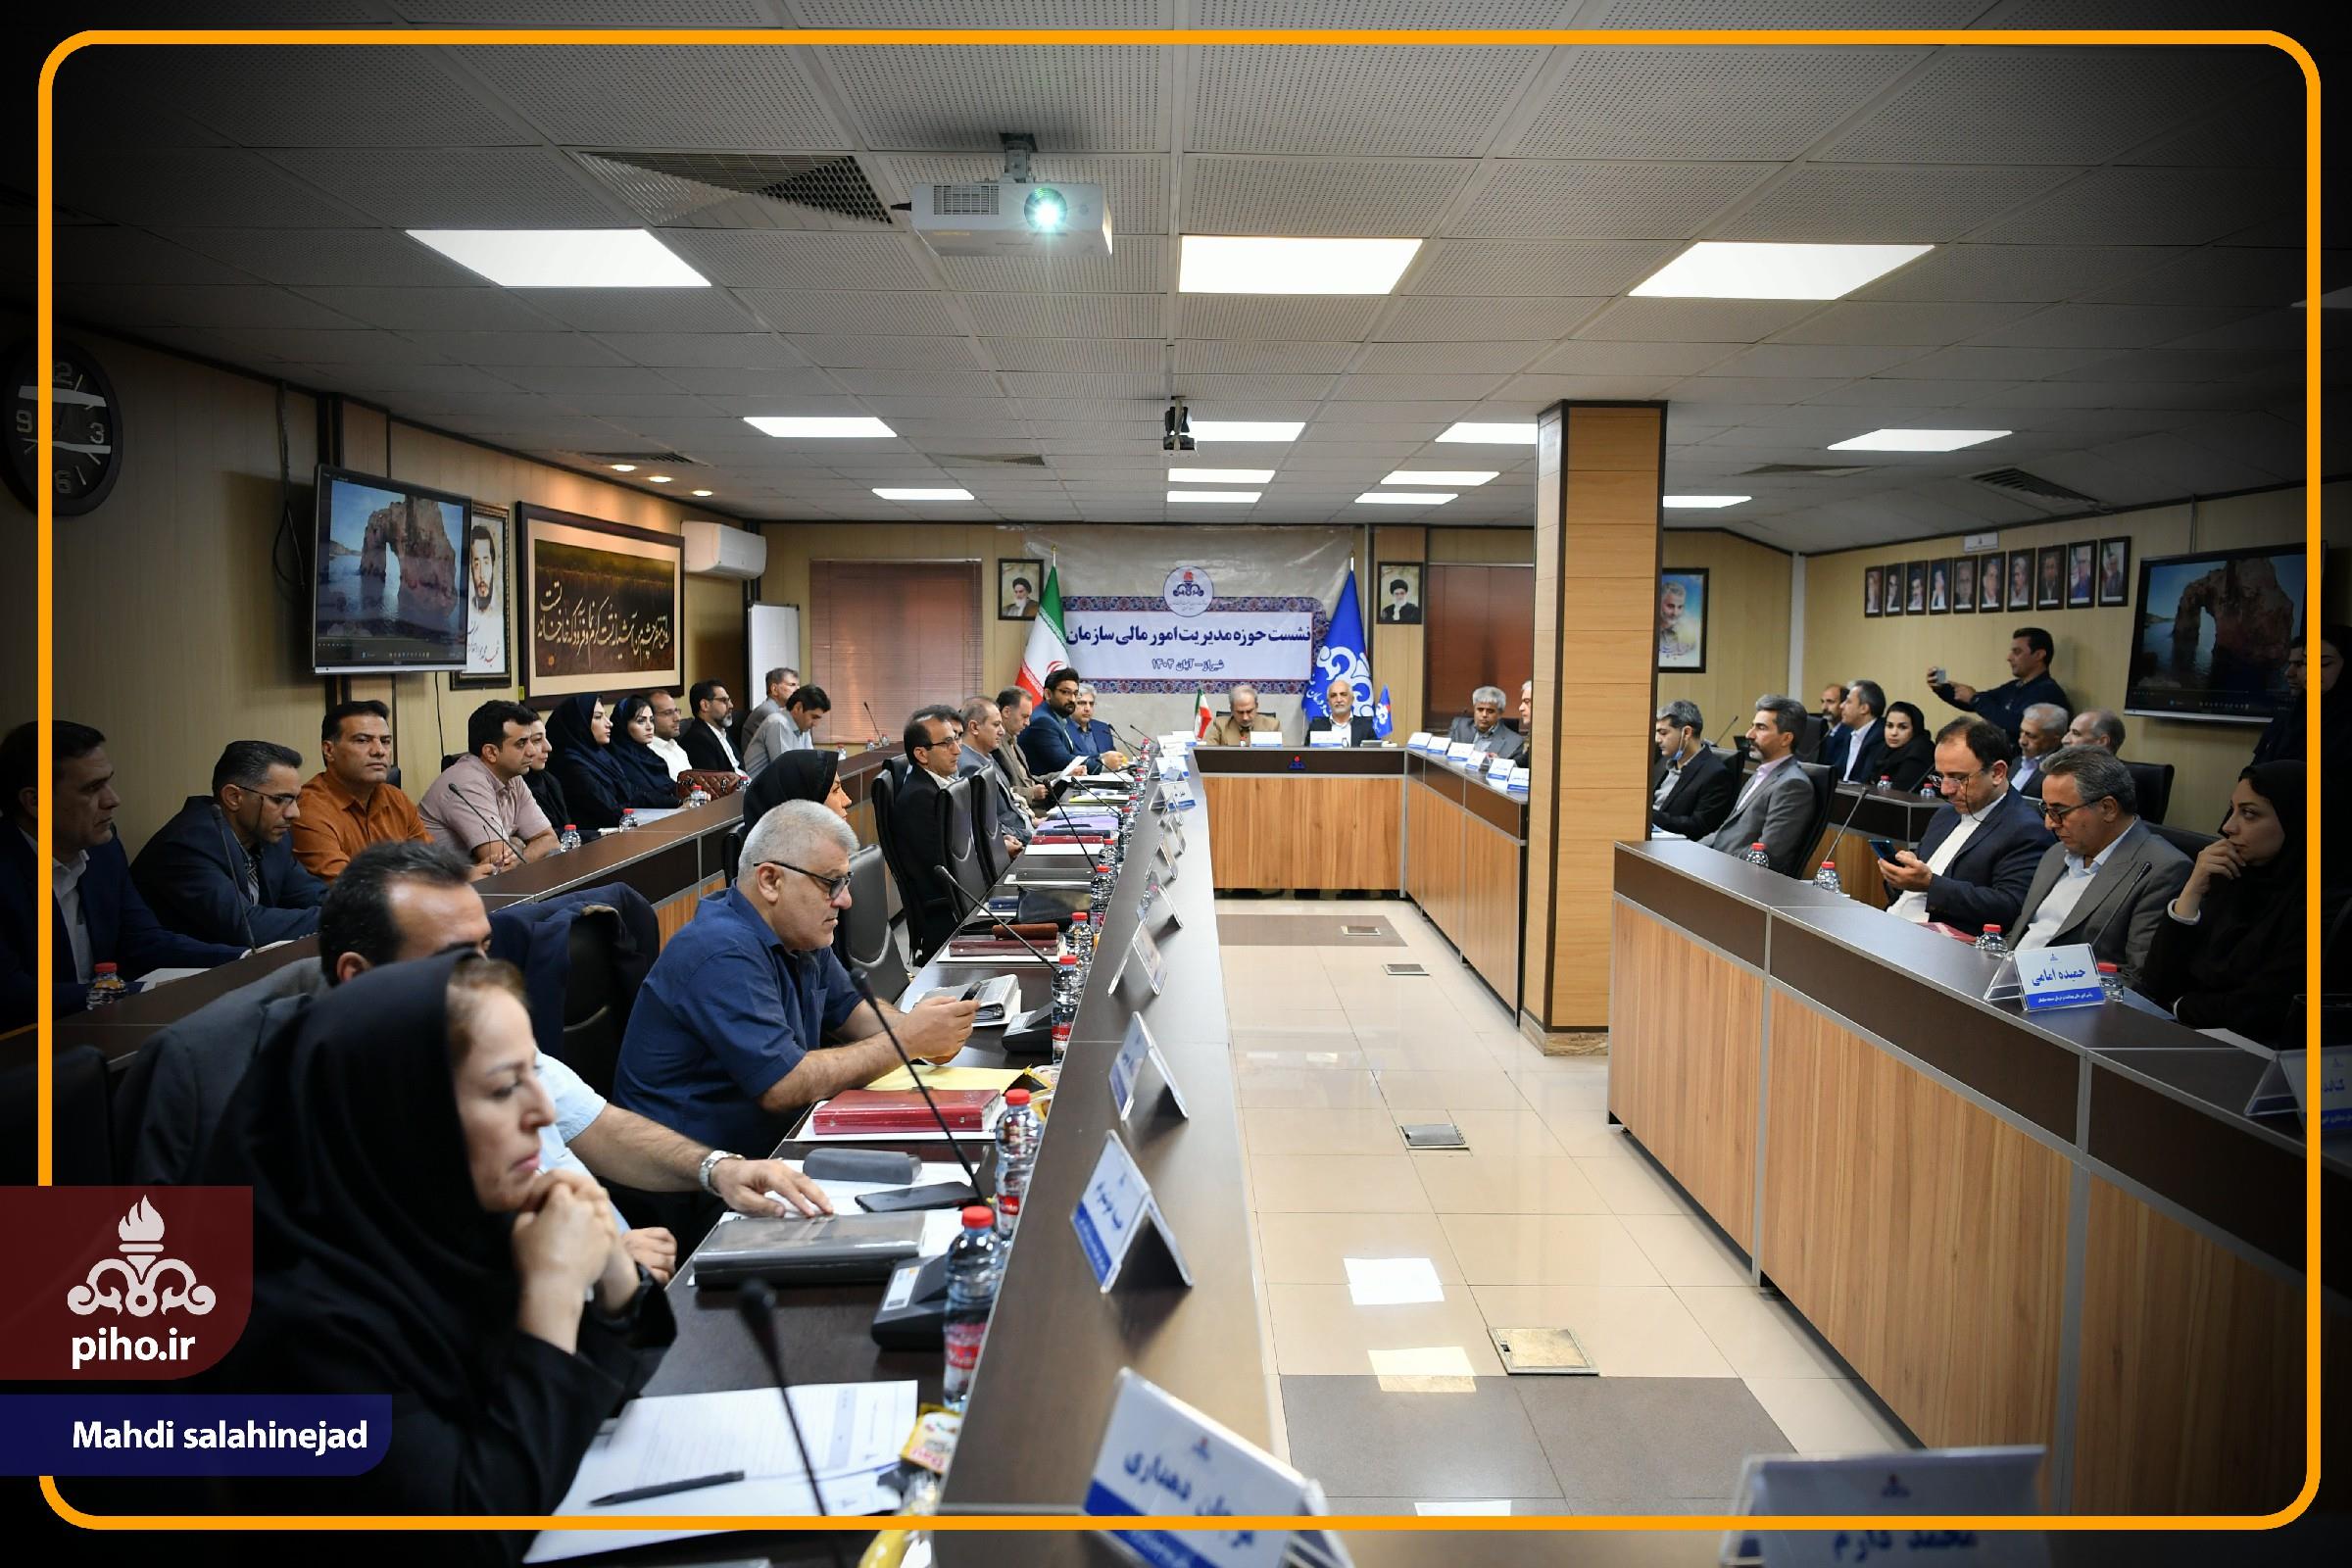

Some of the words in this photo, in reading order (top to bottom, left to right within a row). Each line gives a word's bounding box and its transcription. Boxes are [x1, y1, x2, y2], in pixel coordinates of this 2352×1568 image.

[89, 422, 106, 445] 3
[1065, 624, 1115, 646] سازمان
[1115, 624, 1149, 646] مالی
[1149, 625, 1179, 646] امور
[1178, 628, 1233, 647] مدیریت
[1233, 627, 1267, 647] حوزه
[1268, 626, 1311, 642] نشست
[2032, 967, 2057, 987] امامی
[2058, 968, 2086, 982] حمیده
